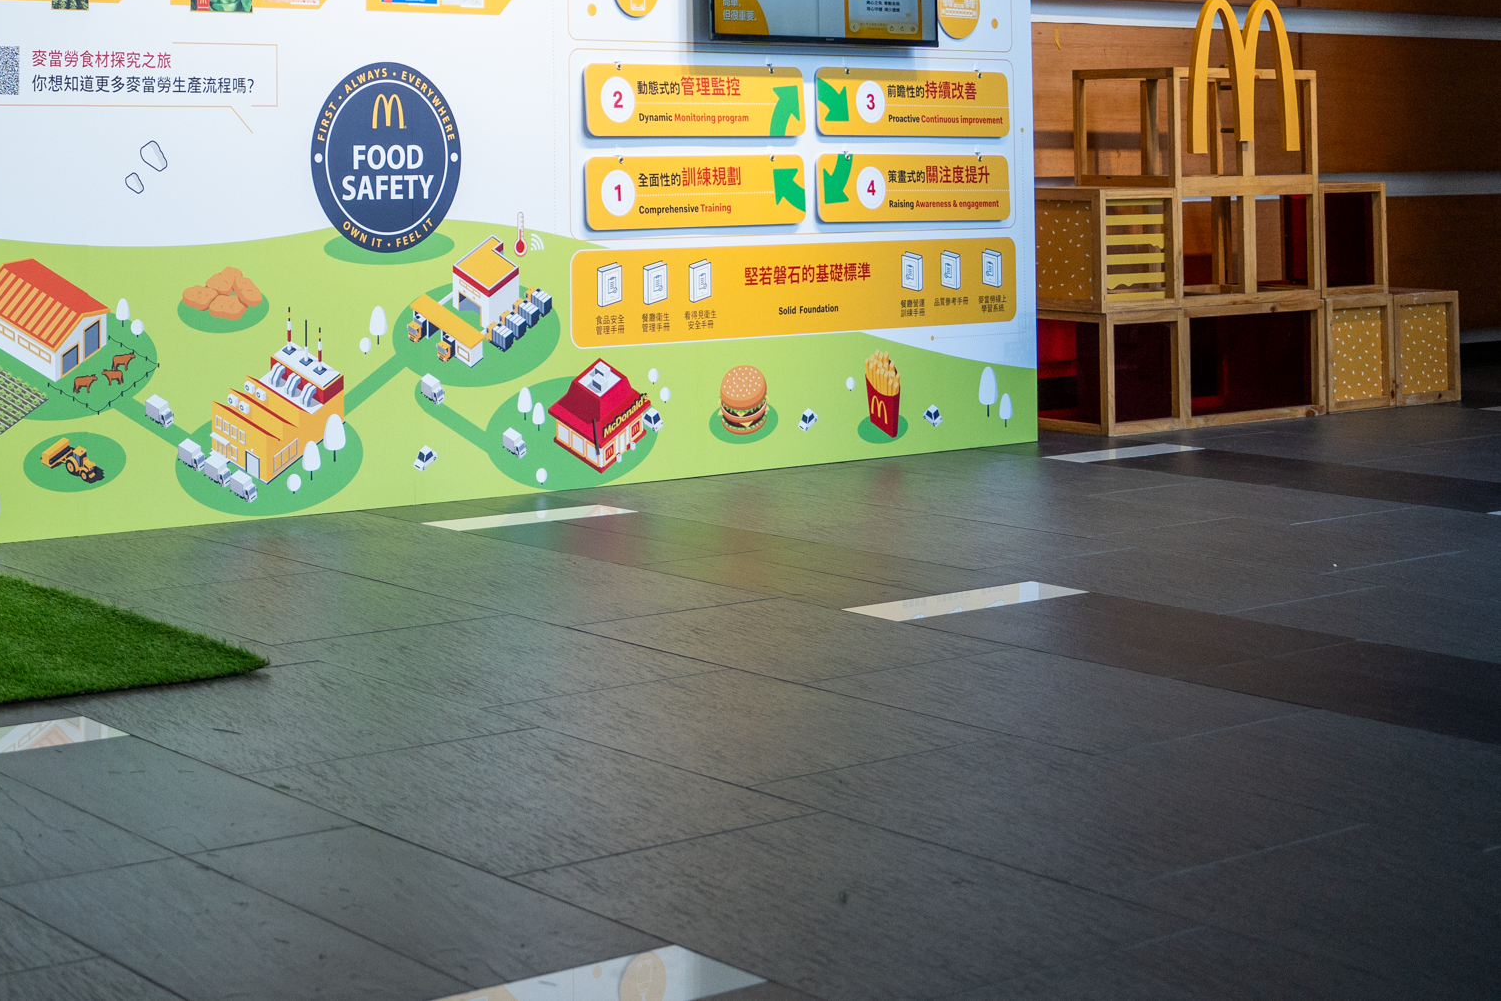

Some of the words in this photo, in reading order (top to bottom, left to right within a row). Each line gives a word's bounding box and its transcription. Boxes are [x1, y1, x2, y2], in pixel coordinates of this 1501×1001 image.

[32, 49, 171, 69] 麥當勞食材探究之旅
[32, 74, 255, 94] 你想知道更多麥當勞生產流程嗎?
[637, 76, 741, 97] 動態式的管理監控
[887, 81, 977, 100] 前瞻性的持續改善
[317, 102, 337, 141] FIRST
[344, 68, 388, 94] ALWAYS
[401, 71, 455, 141] EVERYWHERE
[612, 91, 623, 108] 2
[866, 93, 875, 110] 3
[639, 113, 673, 124] Dynamic
[674, 113, 716, 125] Monitoring
[717, 114, 749, 124] program
[888, 114, 920, 123] Proactive
[921, 115, 959, 124] Continuous
[960, 115, 1003, 125] improvement
[353, 144, 424, 170] FOOD
[638, 166, 741, 187] 全面性的訓練規劃
[342, 174, 434, 200] SAFETY
[614, 184, 622, 201] 1
[867, 180, 876, 195] 4
[639, 205, 699, 216] Comprehensive
[700, 204, 731, 214] Training
[889, 200, 914, 209] Raising
[915, 199, 951, 208] Awareness
[953, 199, 958, 208] &
[959, 200, 999, 210] engagement
[343, 221, 367, 243] OWN
[371, 237, 382, 247] IT
[396, 229, 421, 247] FEEL
[422, 218, 434, 232] IT
[744, 262, 871, 286] 堅若磐石的基礎標準
[778, 306, 796, 315] Solid
[799, 304, 838, 314] Foundation
[595, 314, 625, 325] 食品安全
[602, 393, 648, 438] McDonald's
